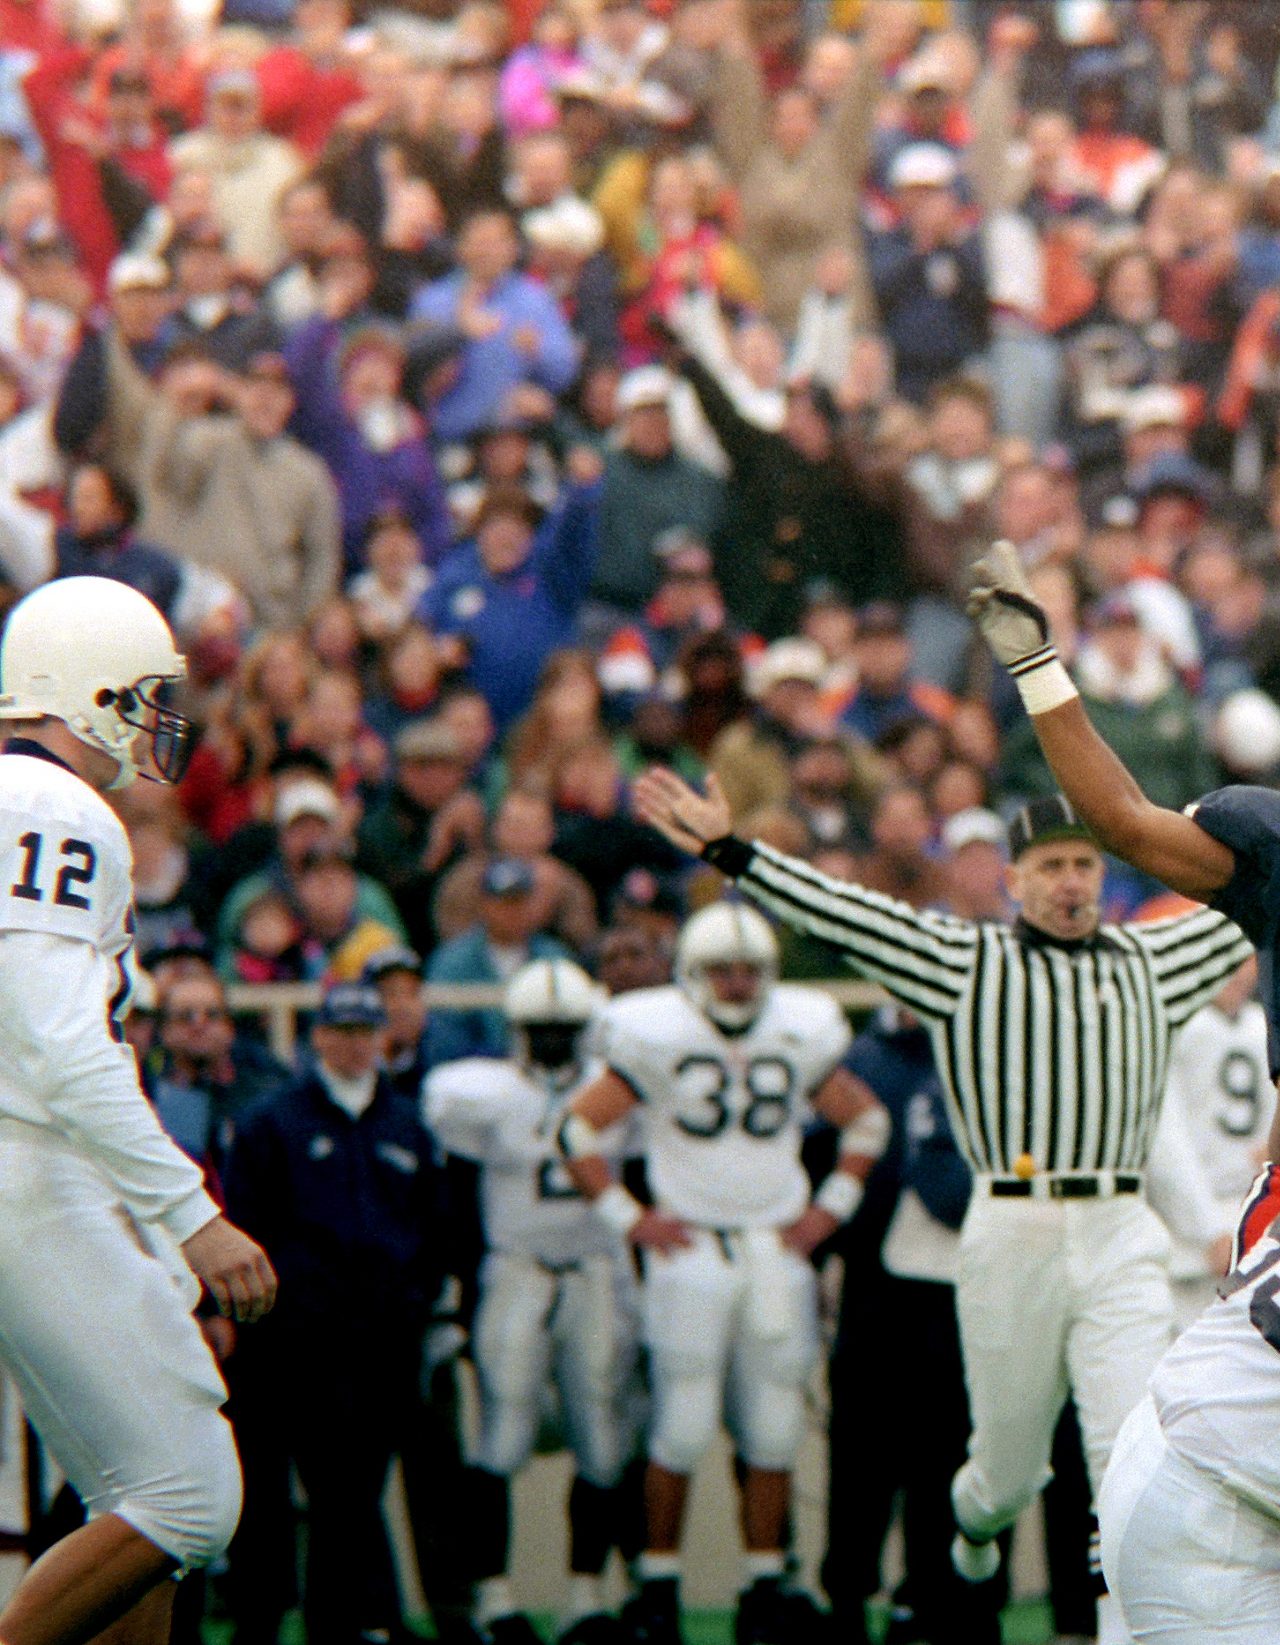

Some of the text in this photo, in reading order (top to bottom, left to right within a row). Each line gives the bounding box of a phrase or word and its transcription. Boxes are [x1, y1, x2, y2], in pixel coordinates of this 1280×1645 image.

[10, 831, 97, 911] 12
[675, 1053, 794, 1138] 38
[1215, 1046, 1262, 1137] 9
